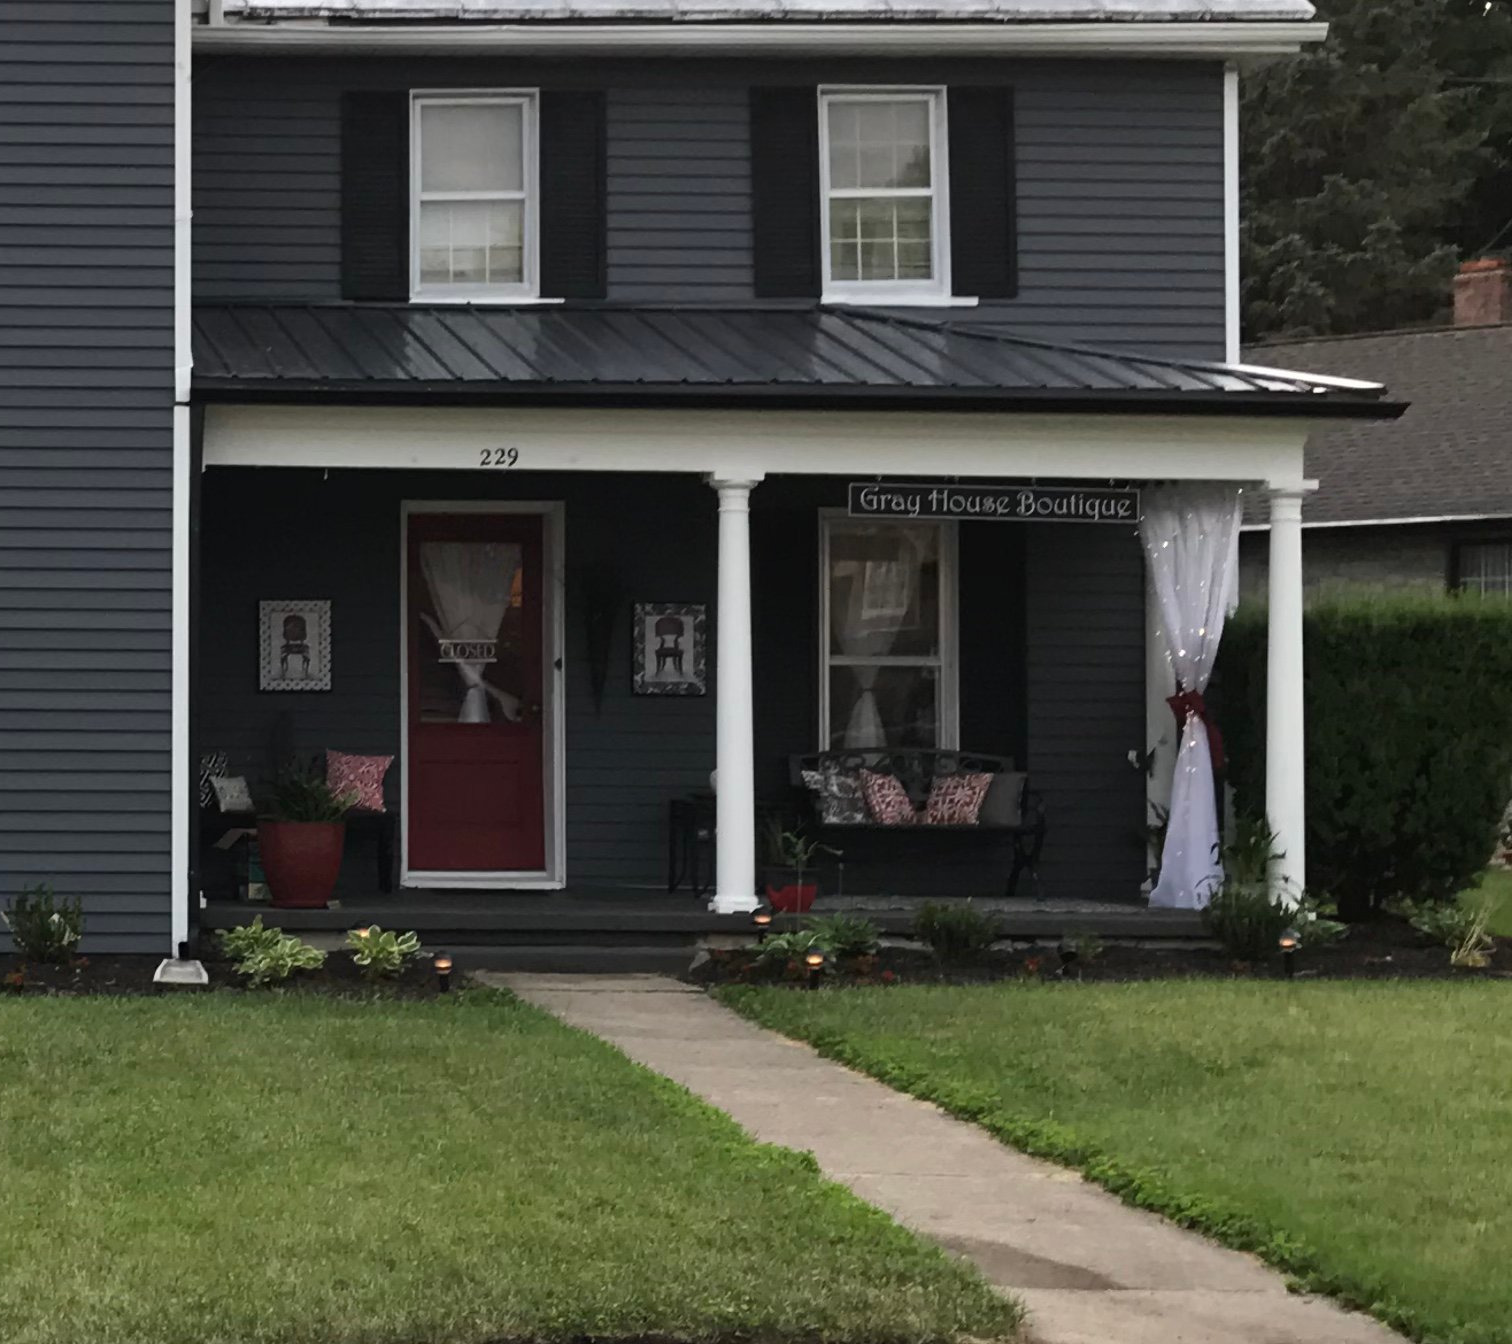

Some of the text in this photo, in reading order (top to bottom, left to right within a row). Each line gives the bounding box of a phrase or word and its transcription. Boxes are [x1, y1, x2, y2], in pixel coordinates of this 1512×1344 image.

[480, 447, 519, 467] 229
[860, 487, 1132, 520] Gray House Boutique
[440, 642, 496, 658] CLOSED
